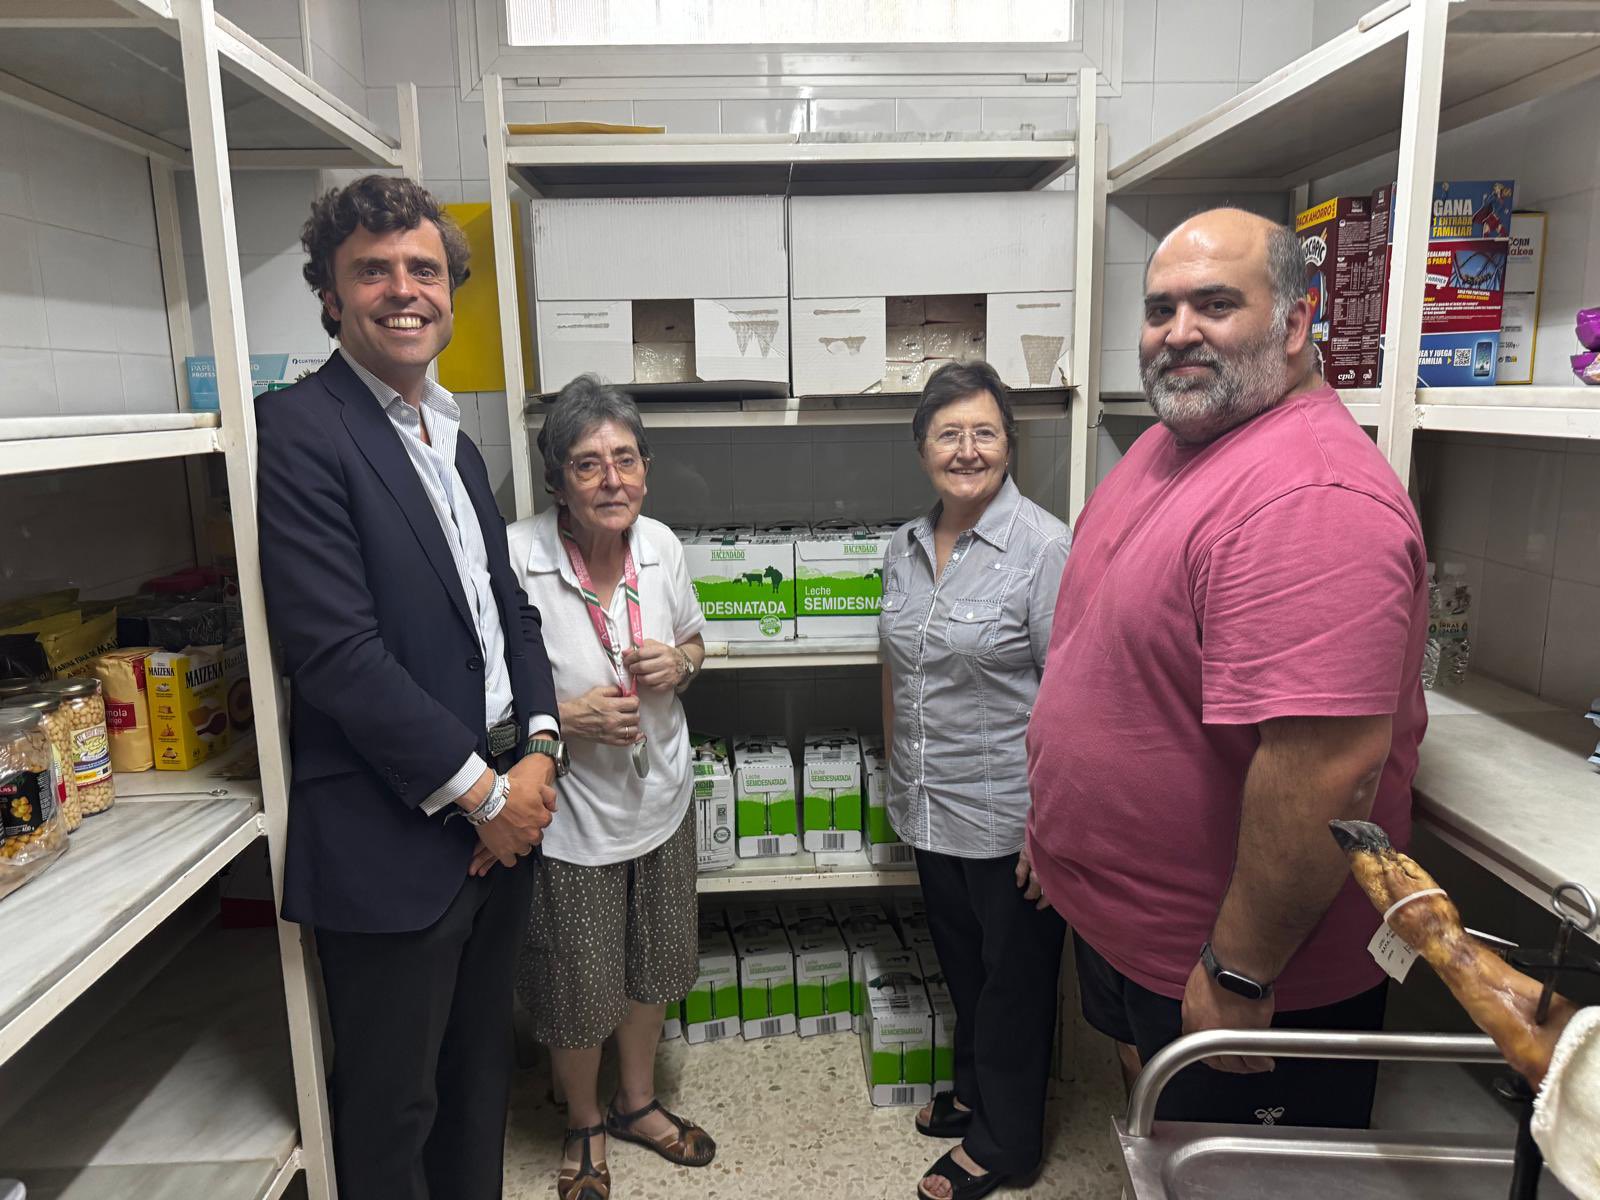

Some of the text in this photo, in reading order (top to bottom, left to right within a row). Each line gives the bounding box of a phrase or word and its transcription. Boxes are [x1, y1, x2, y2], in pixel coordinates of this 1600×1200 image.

[1308, 204, 1332, 221] AHORRO
[1433, 199, 1473, 216] GANA
[1433, 216, 1473, 226] 1 ENTRADA
[1433, 226, 1473, 237] FAMILIAR
[1432, 257, 1447, 265] PARA
[1434, 349, 1453, 357] JUEGA
[1419, 357, 1443, 365] FAMILIA
[843, 543, 878, 554] HACENDADO
[711, 550, 746, 560] HACENDADO
[804, 585, 832, 596] Leche
[702, 600, 787, 615] IDESNATADA
[804, 596, 883, 611] SEMIDESNA
[149, 666, 176, 677] MAIZENA
[185, 661, 224, 689] MAIZENA
[105, 708, 128, 718] mola
[745, 778, 787, 786] SEMIDESNATADA
[811, 774, 852, 782] SEMIDESNATADA
